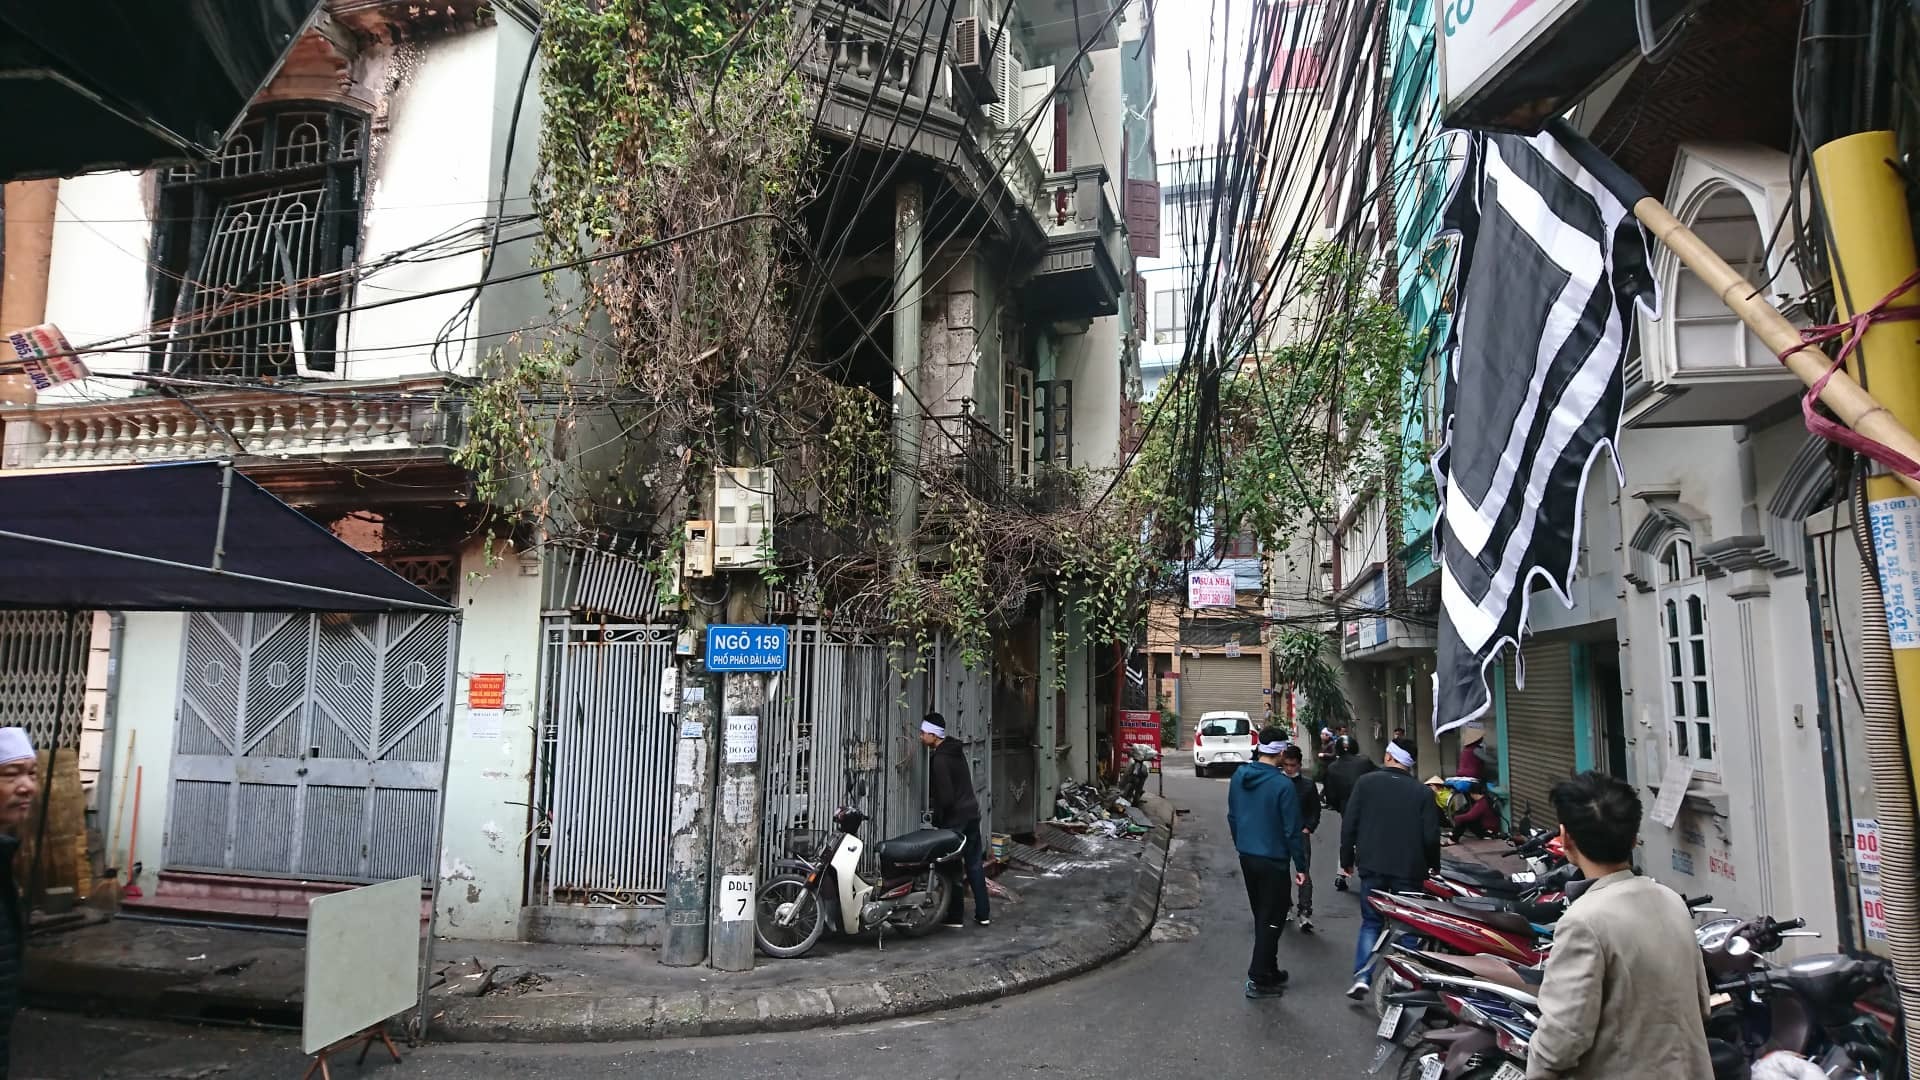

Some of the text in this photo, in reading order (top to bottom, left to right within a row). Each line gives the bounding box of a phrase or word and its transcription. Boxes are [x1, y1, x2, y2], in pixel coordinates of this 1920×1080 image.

[715, 631, 780, 650] NGÕ 159
[714, 652, 781, 665] PHỐ PHÁO ĐÀI LÁNG
[737, 898, 747, 916] 7
